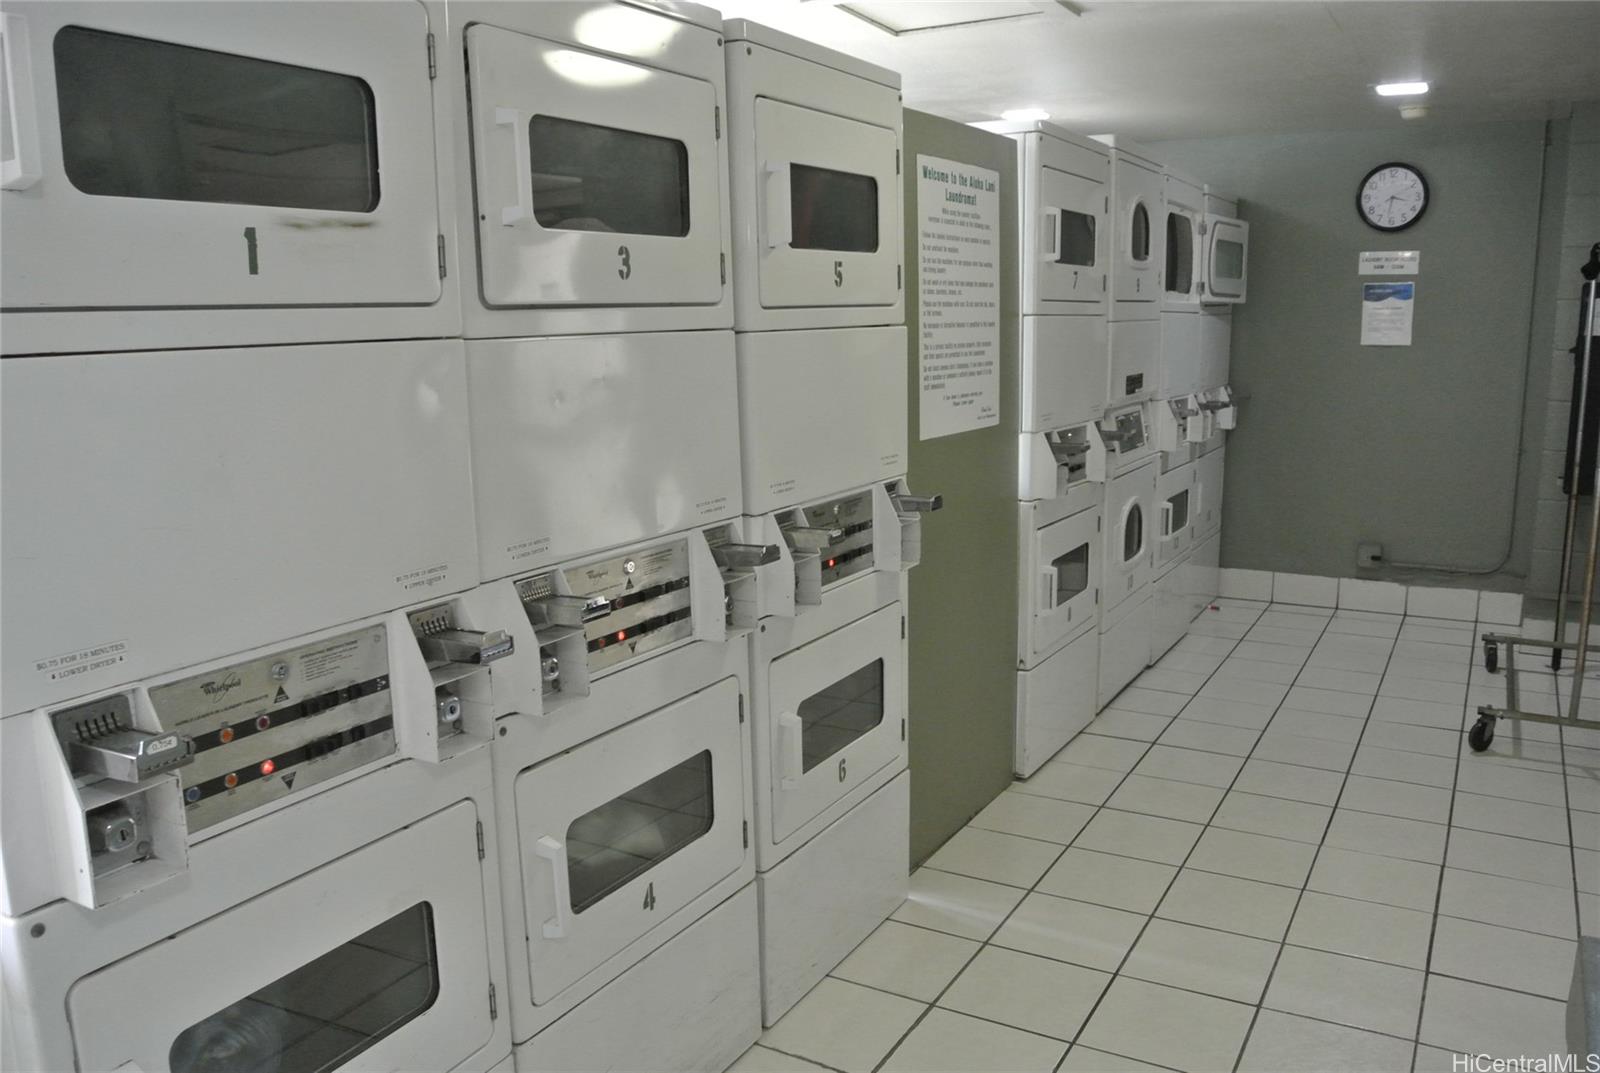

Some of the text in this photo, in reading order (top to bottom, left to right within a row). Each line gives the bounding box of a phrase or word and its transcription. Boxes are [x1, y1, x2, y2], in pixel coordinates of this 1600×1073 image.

[922, 165, 949, 183] Welcome
[951, 171, 957, 184] to
[958, 173, 968, 187] the
[969, 176, 984, 190] Aloha
[1390, 169, 1399, 178] 12
[1410, 180, 1417, 189] 2
[1364, 194, 1371, 203] 9
[1415, 191, 1421, 201] 3
[1368, 206, 1375, 215] 8
[1377, 214, 1383, 223] 7
[1401, 213, 1407, 222] 5
[1388, 216, 1395, 226] 6
[243, 226, 259, 275] 1
[618, 245, 631, 280] 3
[834, 260, 843, 287] 5
[60, 654, 77, 665] FOR
[90, 643, 125, 657] MINUTES
[59, 657, 117, 679] LOWER DRYER
[838, 758, 846, 782] 6
[643, 881, 656, 911] 4
